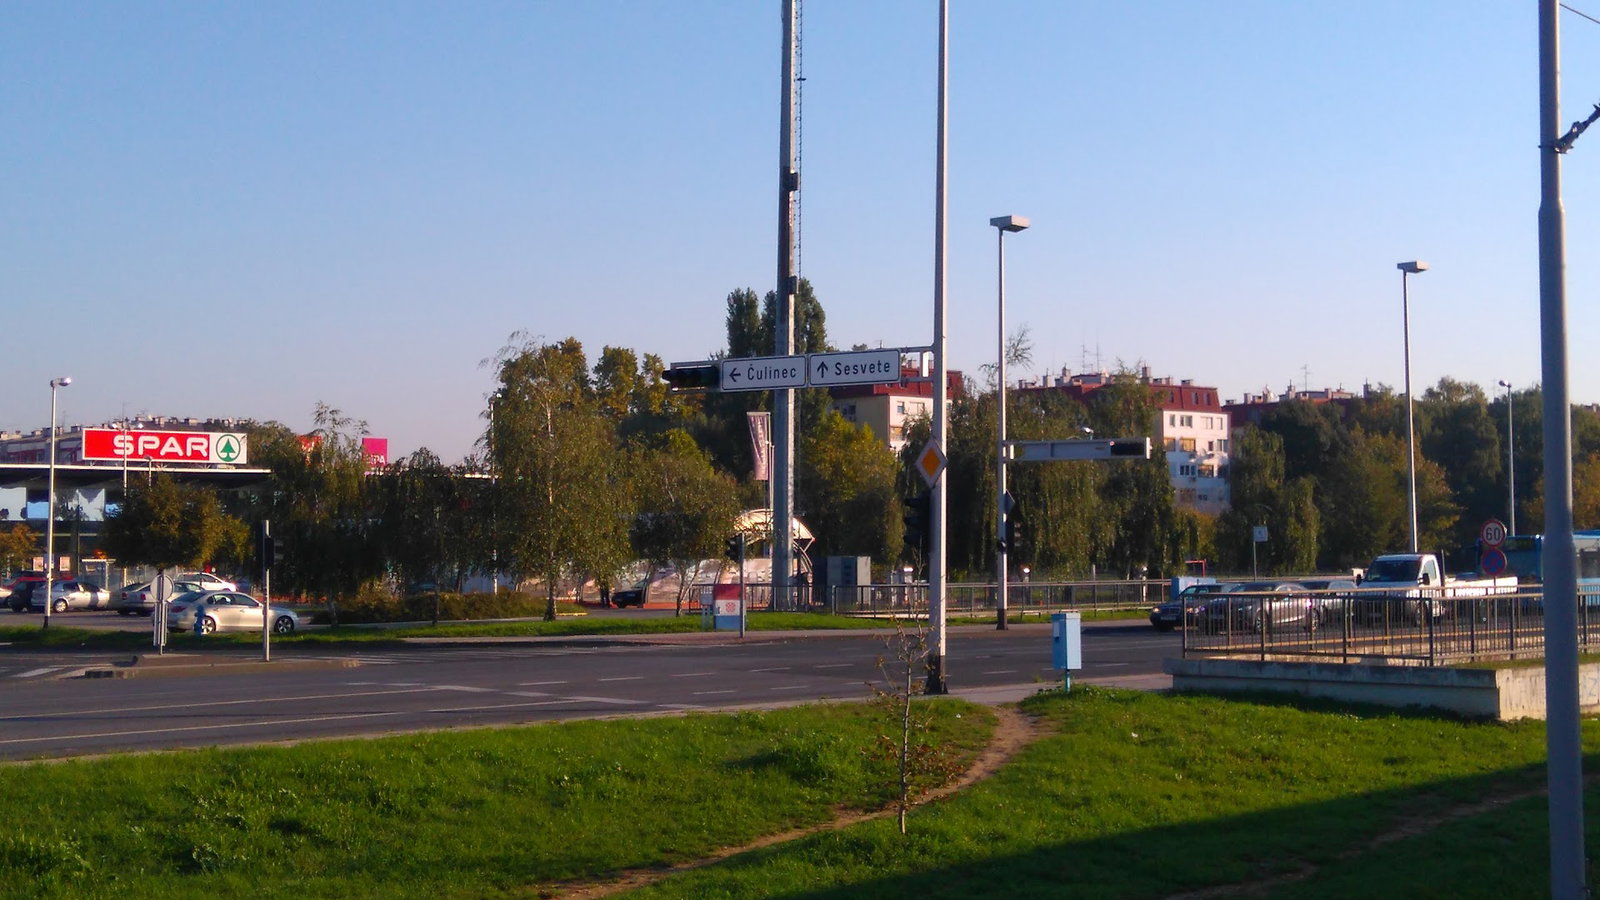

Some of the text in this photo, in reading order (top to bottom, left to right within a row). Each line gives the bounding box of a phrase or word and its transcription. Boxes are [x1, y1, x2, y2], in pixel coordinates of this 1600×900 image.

[747, 363, 797, 381] Čulinec
[834, 360, 891, 376] Sesvete
[113, 434, 209, 458] SPAR
[1485, 527, 1501, 541] 60
